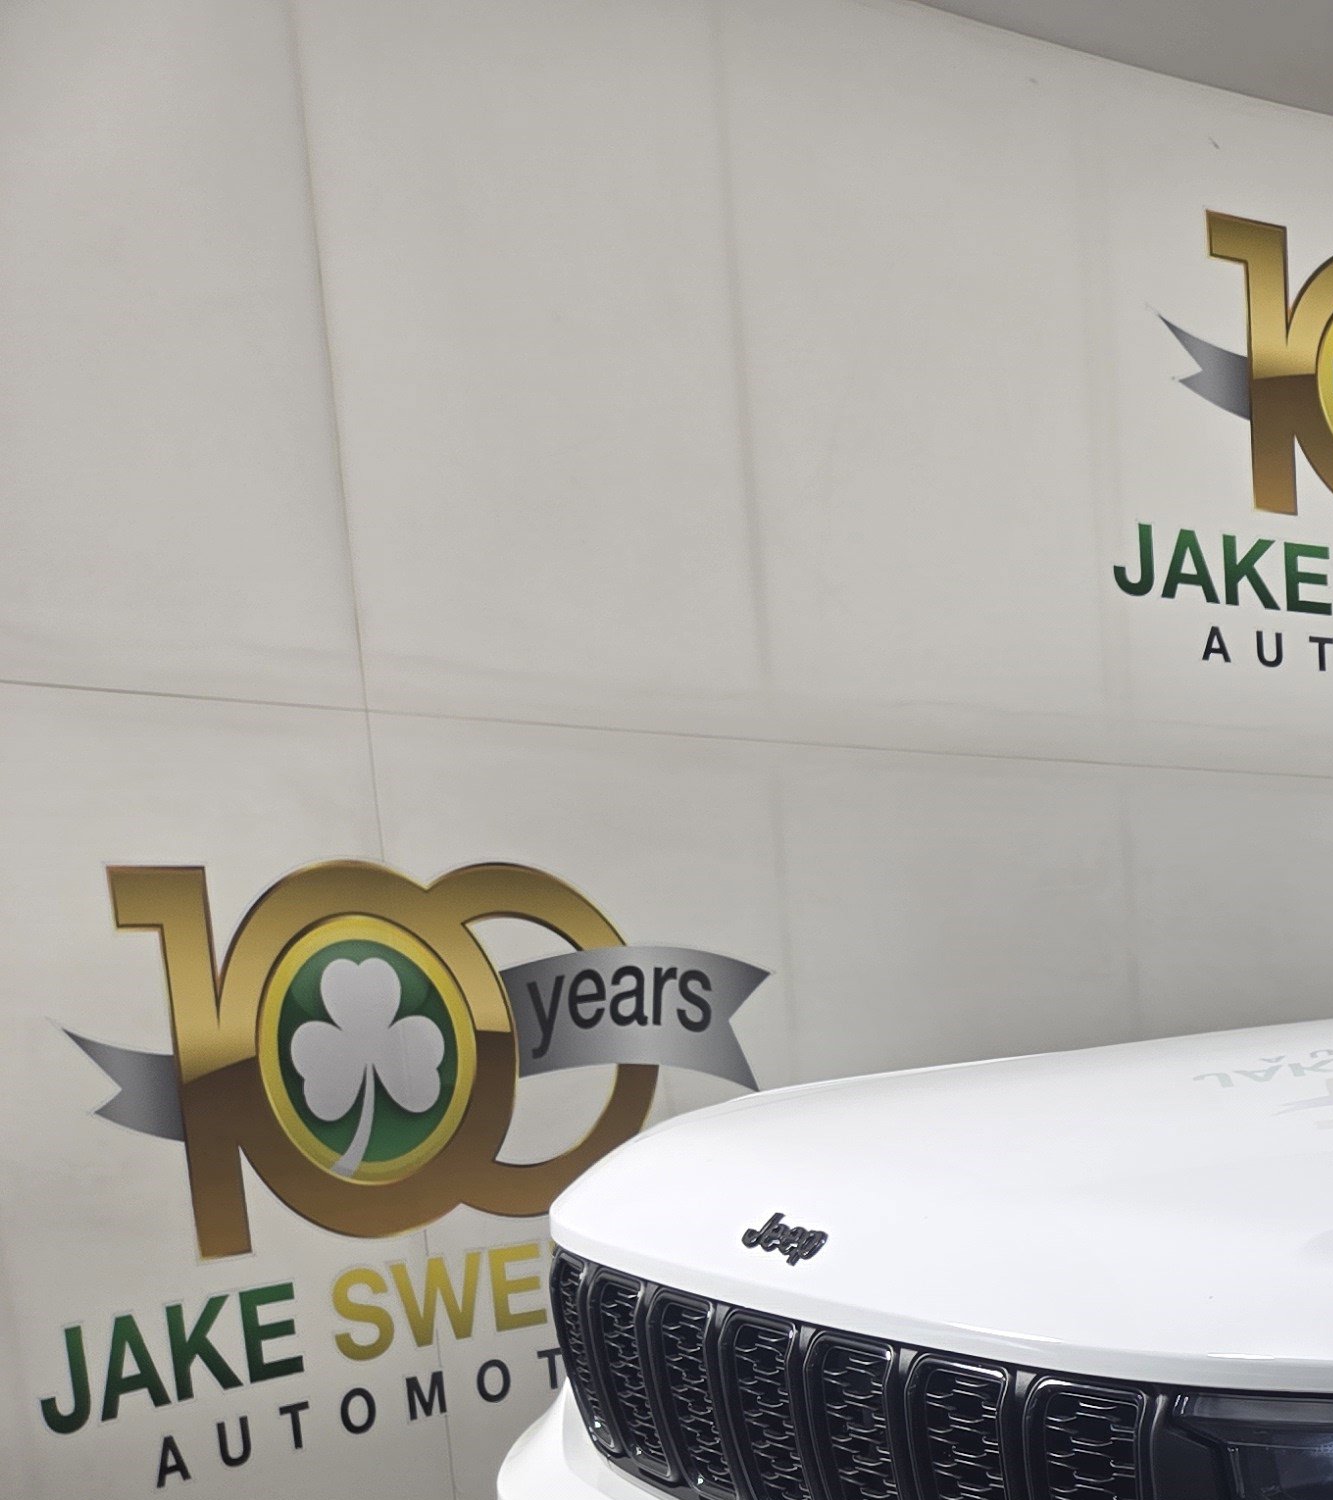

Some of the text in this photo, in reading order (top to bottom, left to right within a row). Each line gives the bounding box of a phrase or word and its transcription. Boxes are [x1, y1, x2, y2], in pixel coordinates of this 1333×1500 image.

[1113, 520, 1333, 616] JAKE
[105, 859, 713, 1262] 100 years
[741, 1211, 829, 1266] Jeep
[39, 1240, 556, 1436] JAKE SWE
